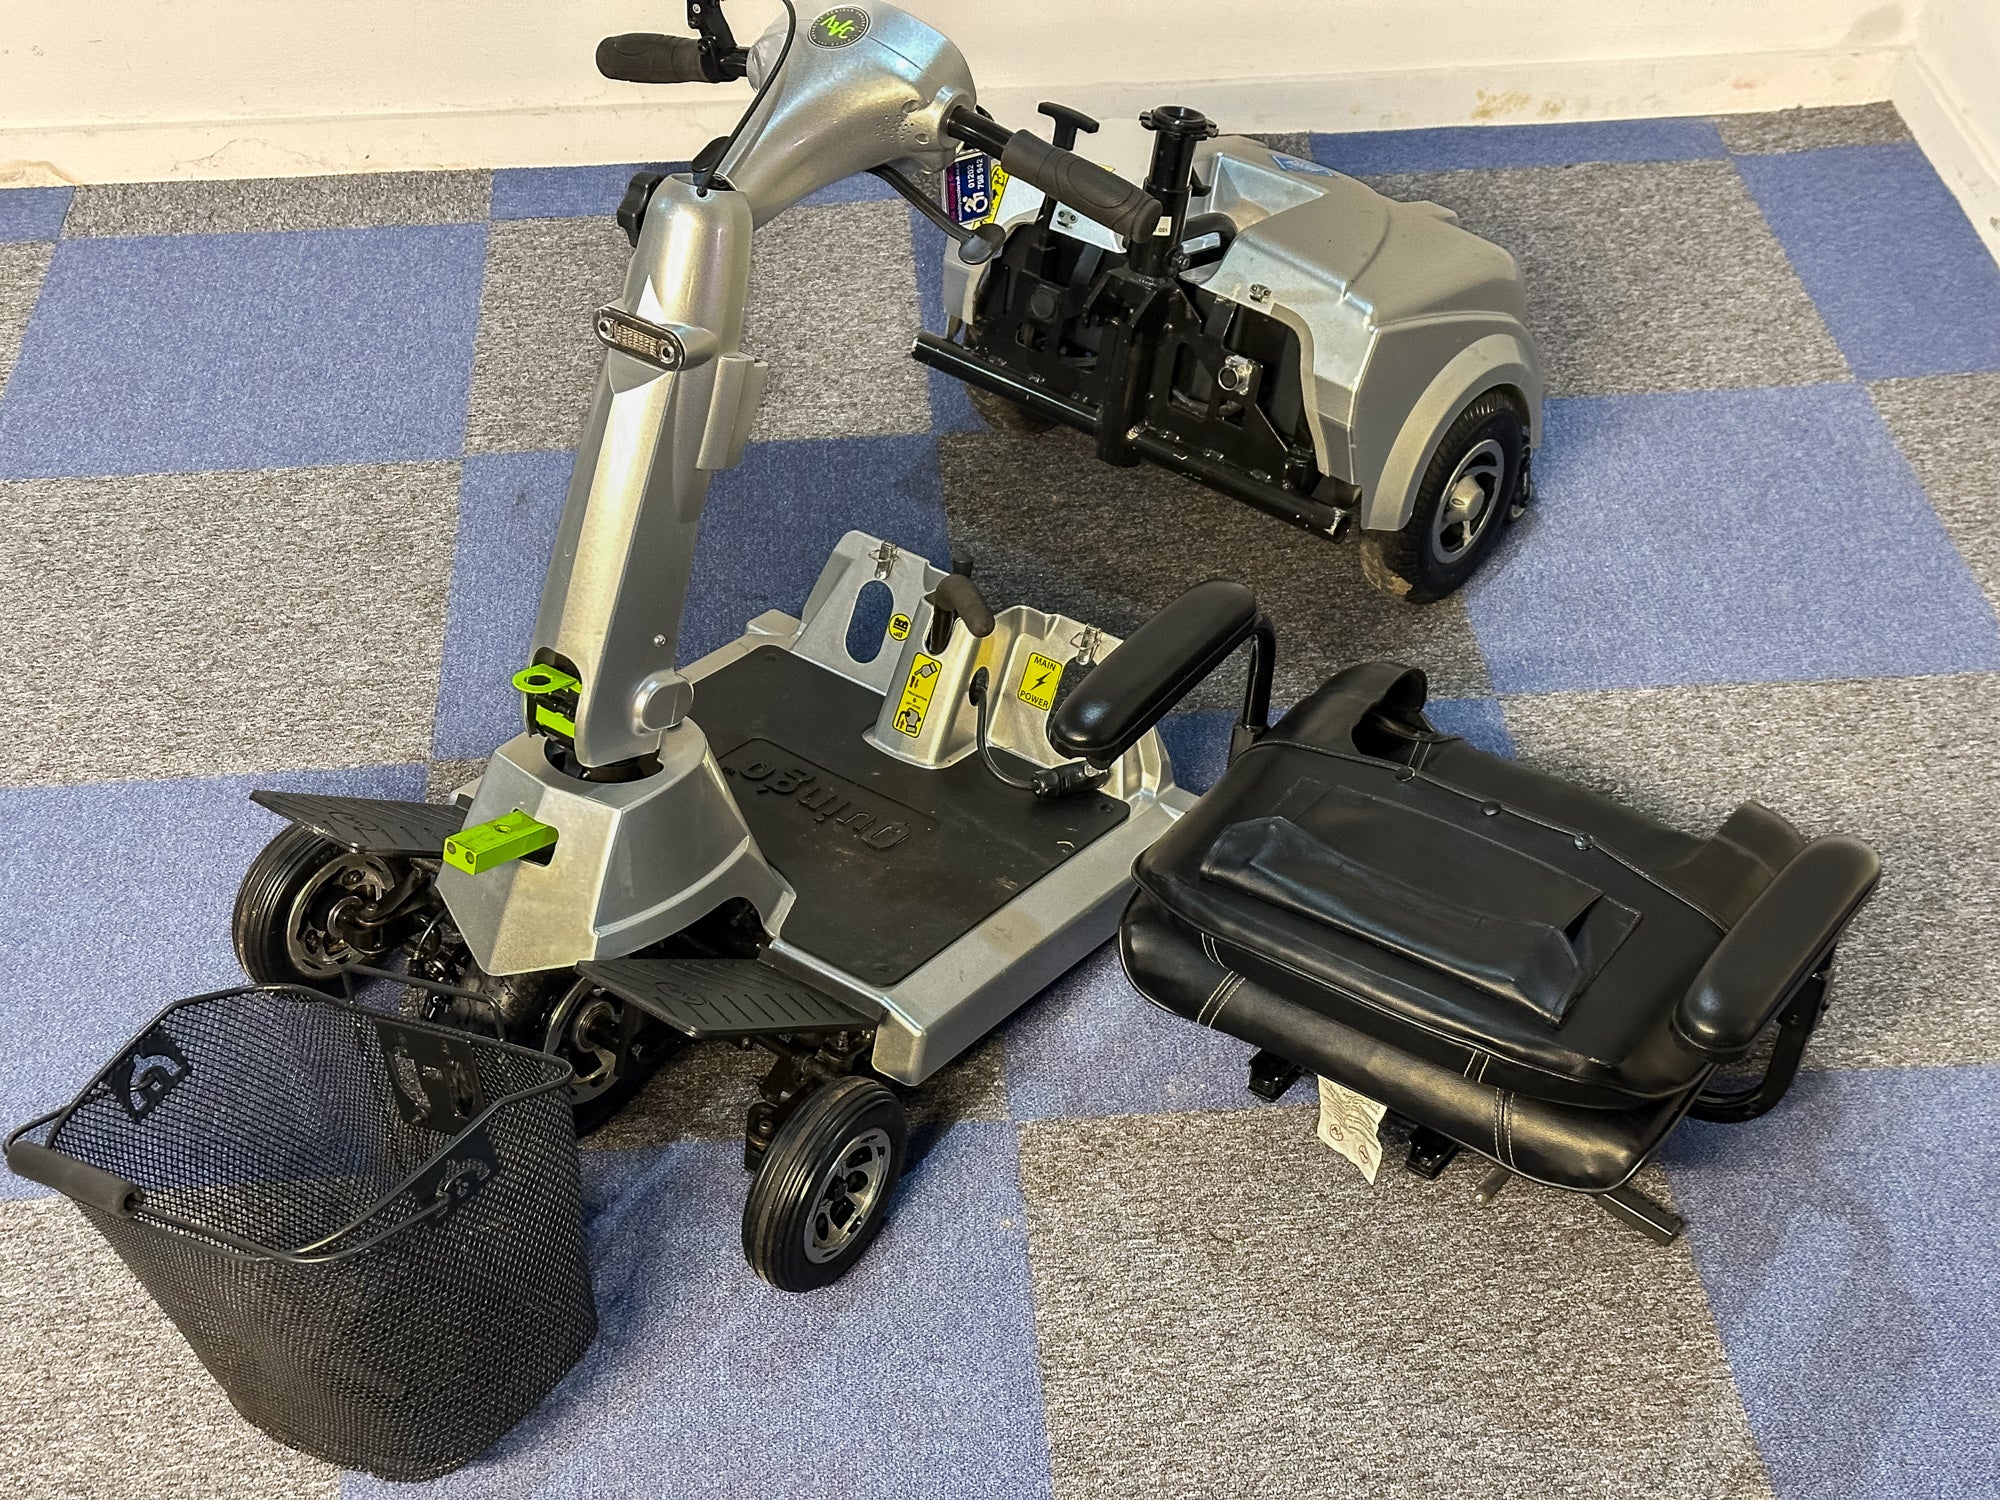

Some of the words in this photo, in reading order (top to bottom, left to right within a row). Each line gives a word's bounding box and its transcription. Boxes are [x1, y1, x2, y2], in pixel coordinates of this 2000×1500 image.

[976, 158, 984, 173] 942
[966, 164, 976, 189] 01202
[1033, 656, 1056, 671] MAIN
[1020, 690, 1049, 708] POWER
